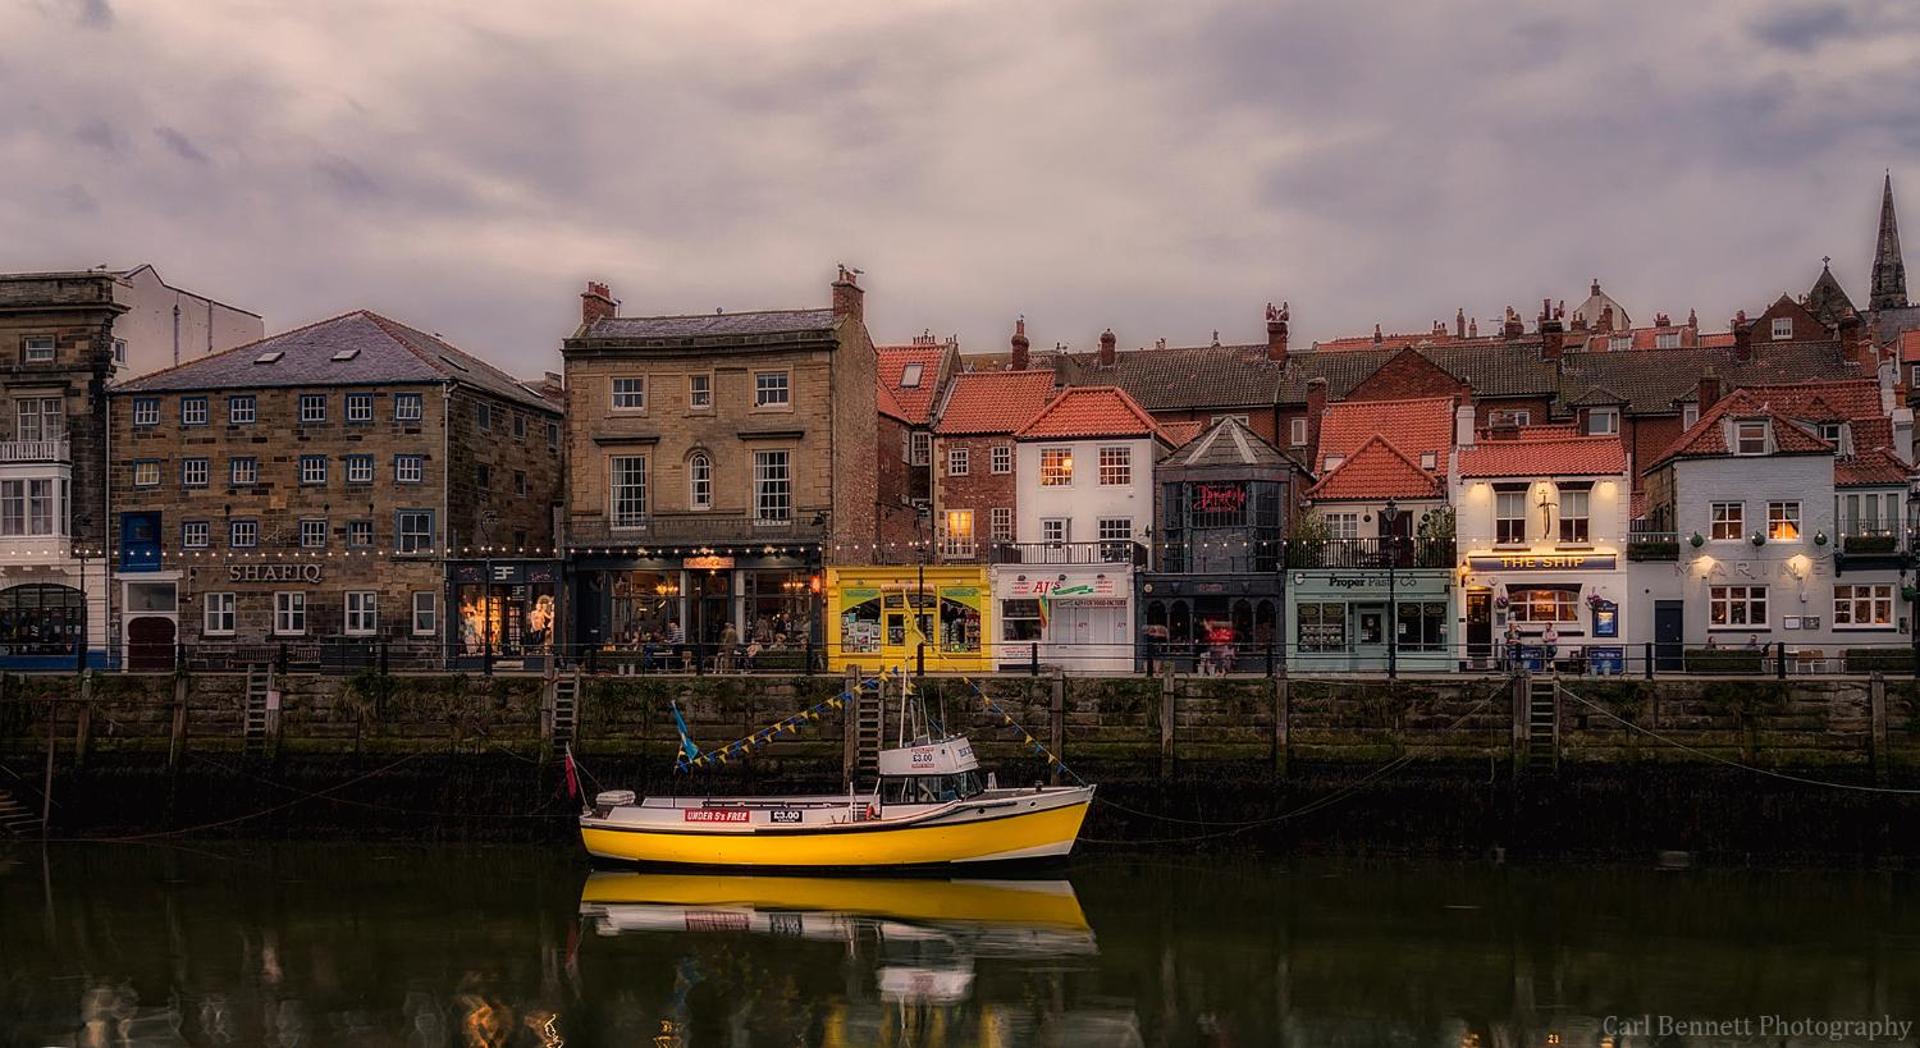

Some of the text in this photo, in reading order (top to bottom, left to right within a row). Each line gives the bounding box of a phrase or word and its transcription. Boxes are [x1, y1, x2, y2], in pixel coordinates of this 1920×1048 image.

[1502, 557, 1584, 568] THE SHIP
[229, 563, 322, 583] SHAFIQ
[1673, 561, 1828, 580] MARINE
[1329, 577, 1365, 589] Proper
[1400, 577, 1417, 587] Co
[687, 810, 714, 820] UNDER
[726, 811, 747, 821] FREE
[773, 811, 800, 820] £3.00
